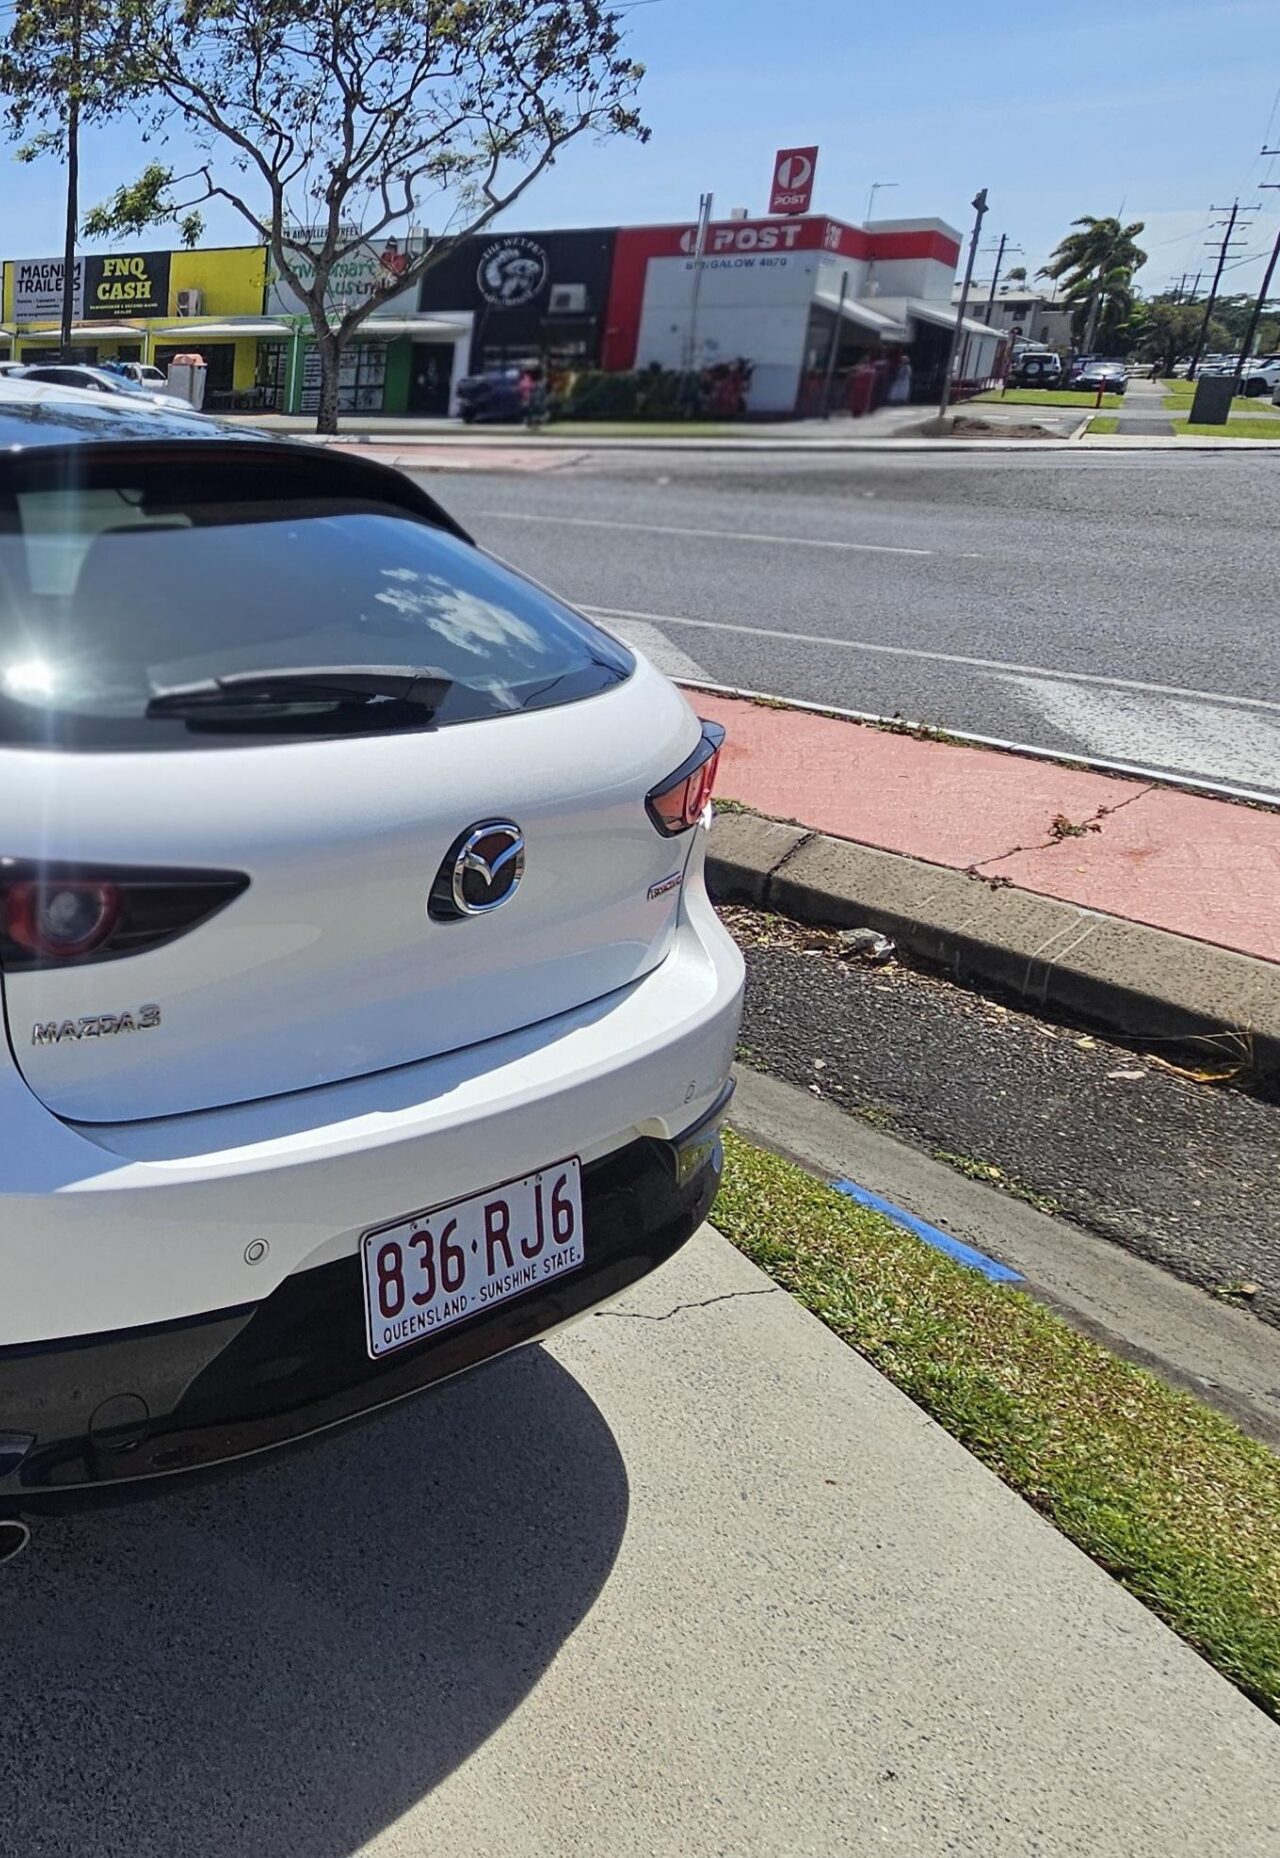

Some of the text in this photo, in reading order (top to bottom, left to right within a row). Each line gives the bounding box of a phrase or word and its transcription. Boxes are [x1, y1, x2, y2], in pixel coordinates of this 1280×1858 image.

[773, 194, 807, 206] POST
[713, 225, 802, 250] POST
[102, 257, 148, 280] FNQ
[759, 257, 788, 267] 4870
[16, 276, 81, 294] TRAILES
[96, 280, 152, 301] CASH
[382, 1294, 469, 1345] QUEENSLAND
[479, 1263, 538, 1303] SUNSHINE
[543, 1245, 577, 1275] STATE
